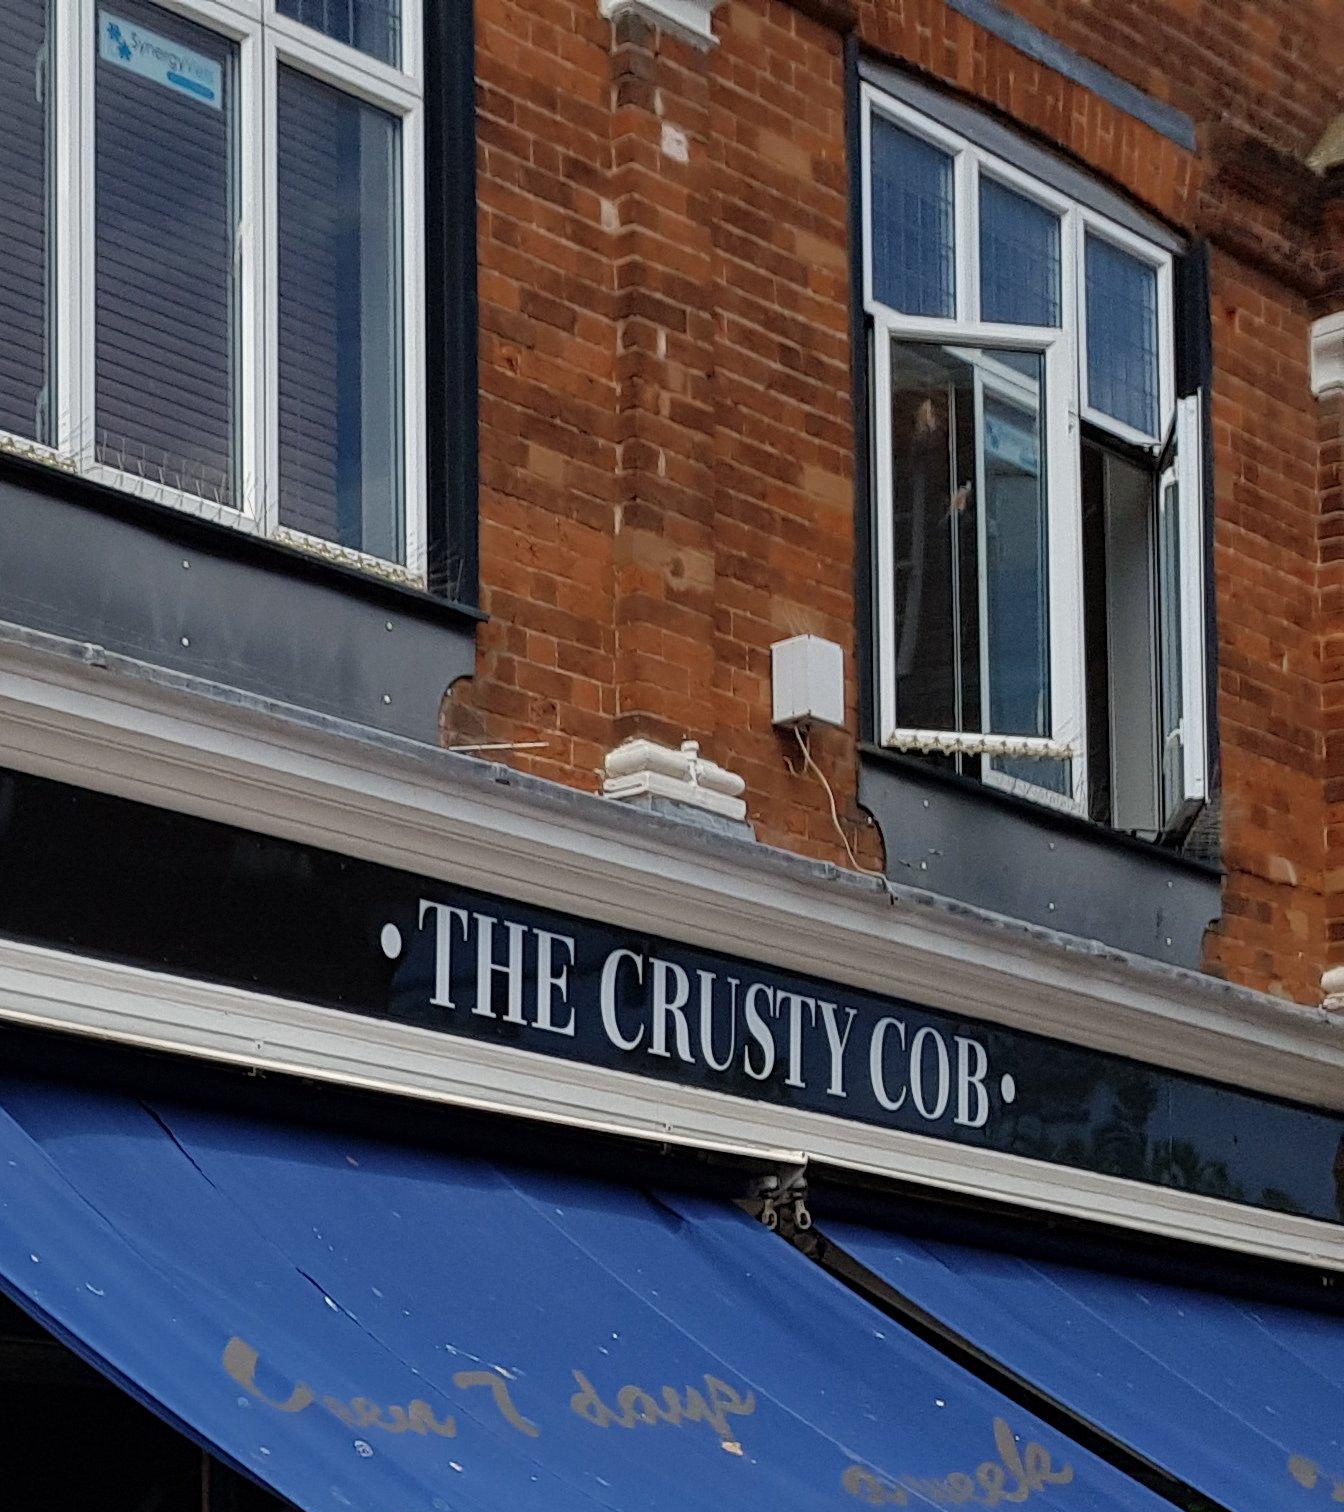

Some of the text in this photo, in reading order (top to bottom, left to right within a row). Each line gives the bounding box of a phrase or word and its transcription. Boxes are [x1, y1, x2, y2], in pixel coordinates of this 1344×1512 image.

[419, 898, 990, 1129] THE CRUSTY COB
